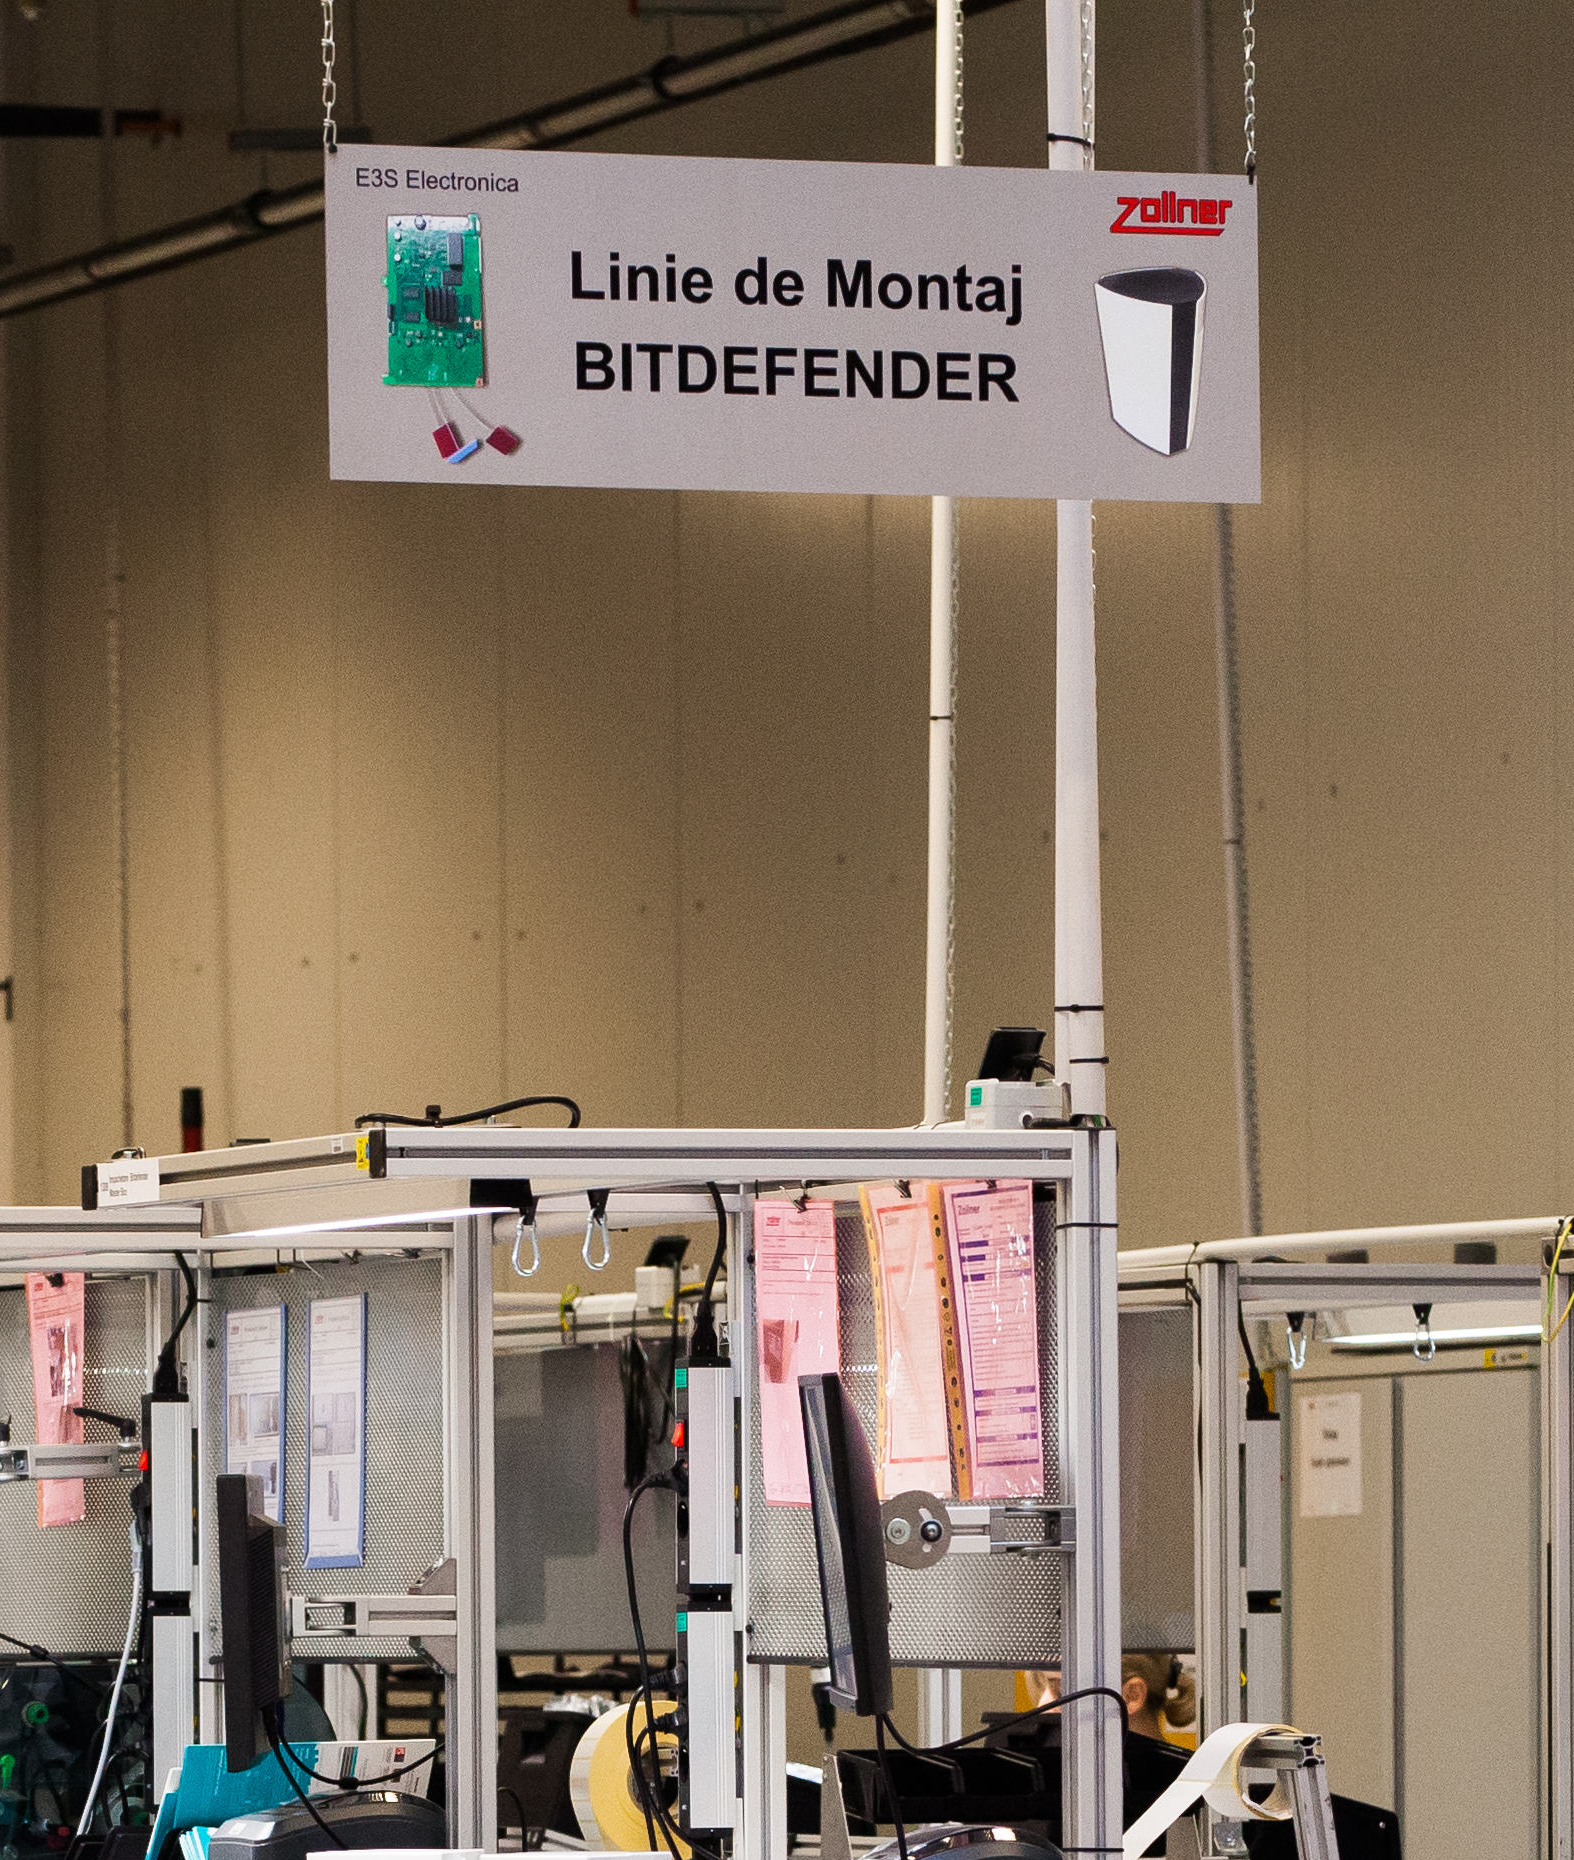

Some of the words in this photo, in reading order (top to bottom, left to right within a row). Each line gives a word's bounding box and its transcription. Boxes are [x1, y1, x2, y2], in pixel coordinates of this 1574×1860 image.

[356, 168, 398, 188] E3S
[406, 169, 519, 192] Electronica
[572, 251, 713, 304] Linie
[735, 257, 804, 306] de
[827, 259, 1022, 326] Montaj
[576, 342, 1019, 402] BITDEFENDER
